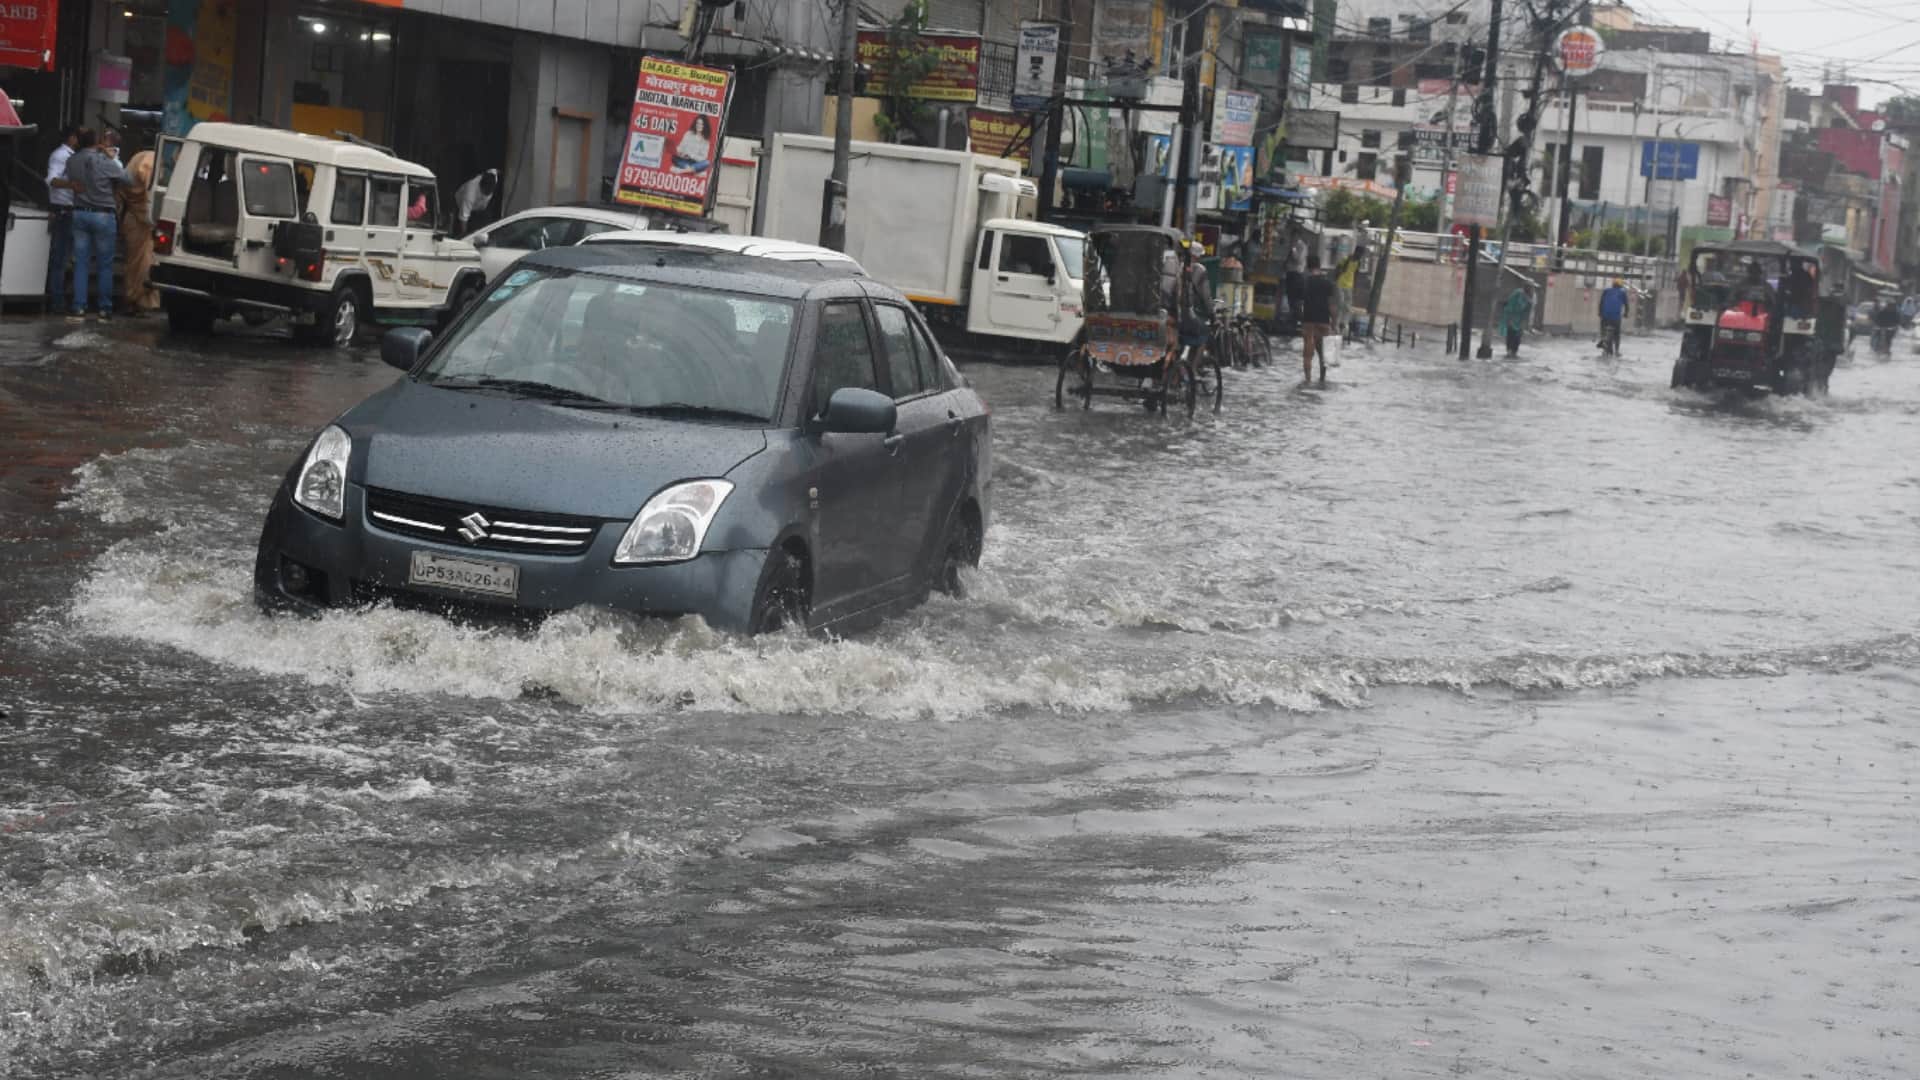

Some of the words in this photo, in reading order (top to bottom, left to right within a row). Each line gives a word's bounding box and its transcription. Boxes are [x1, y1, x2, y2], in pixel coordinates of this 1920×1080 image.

[639, 90, 669, 107] DIGITAL
[670, 94, 719, 115] MARKETING
[634, 114, 648, 129] 45
[651, 116, 678, 134] DAYS
[624, 166, 706, 196] 9795000084
